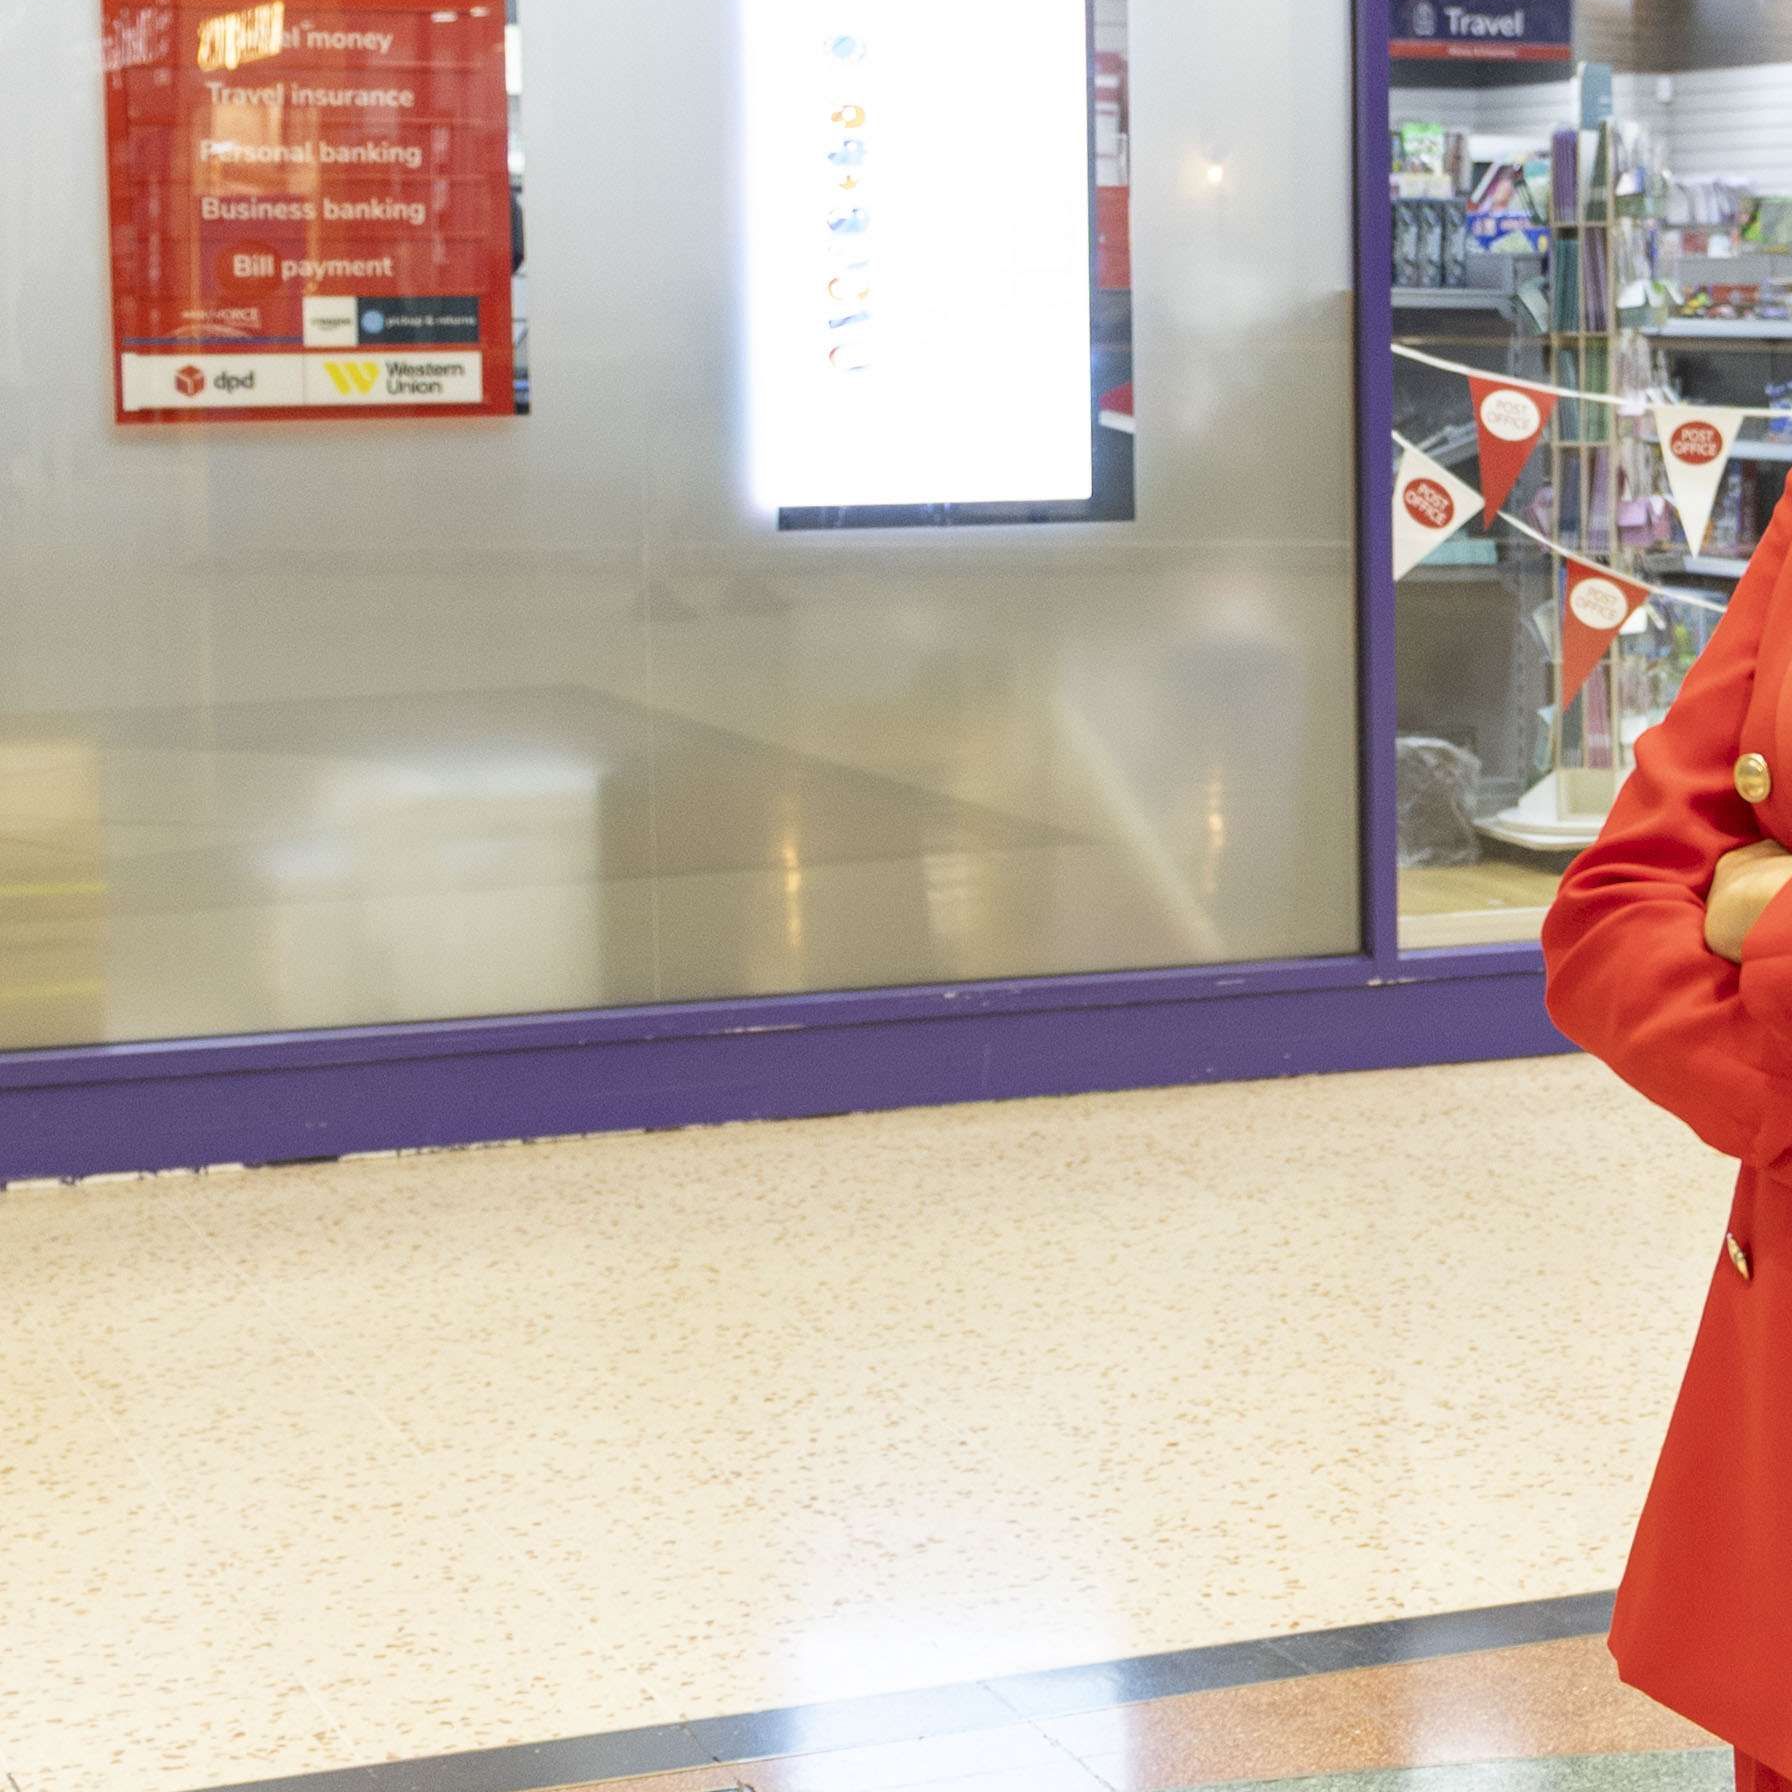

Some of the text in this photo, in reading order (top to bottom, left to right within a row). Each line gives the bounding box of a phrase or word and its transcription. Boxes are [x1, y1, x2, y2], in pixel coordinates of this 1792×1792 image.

[1443, 6, 1525, 37] Travel
[306, 31, 393, 54] money
[205, 80, 415, 108] Travel insurance
[319, 141, 423, 168] banking
[201, 197, 427, 225] Business banking
[233, 254, 393, 282] Bill payment
[213, 370, 255, 394] dpd
[385, 361, 465, 377] Western
[386, 378, 443, 395] Union
[1672, 441, 1717, 457] OFFICE
[1681, 429, 1714, 443] POST
[1405, 489, 1446, 528] OFFICE
[1416, 482, 1449, 512] POST
